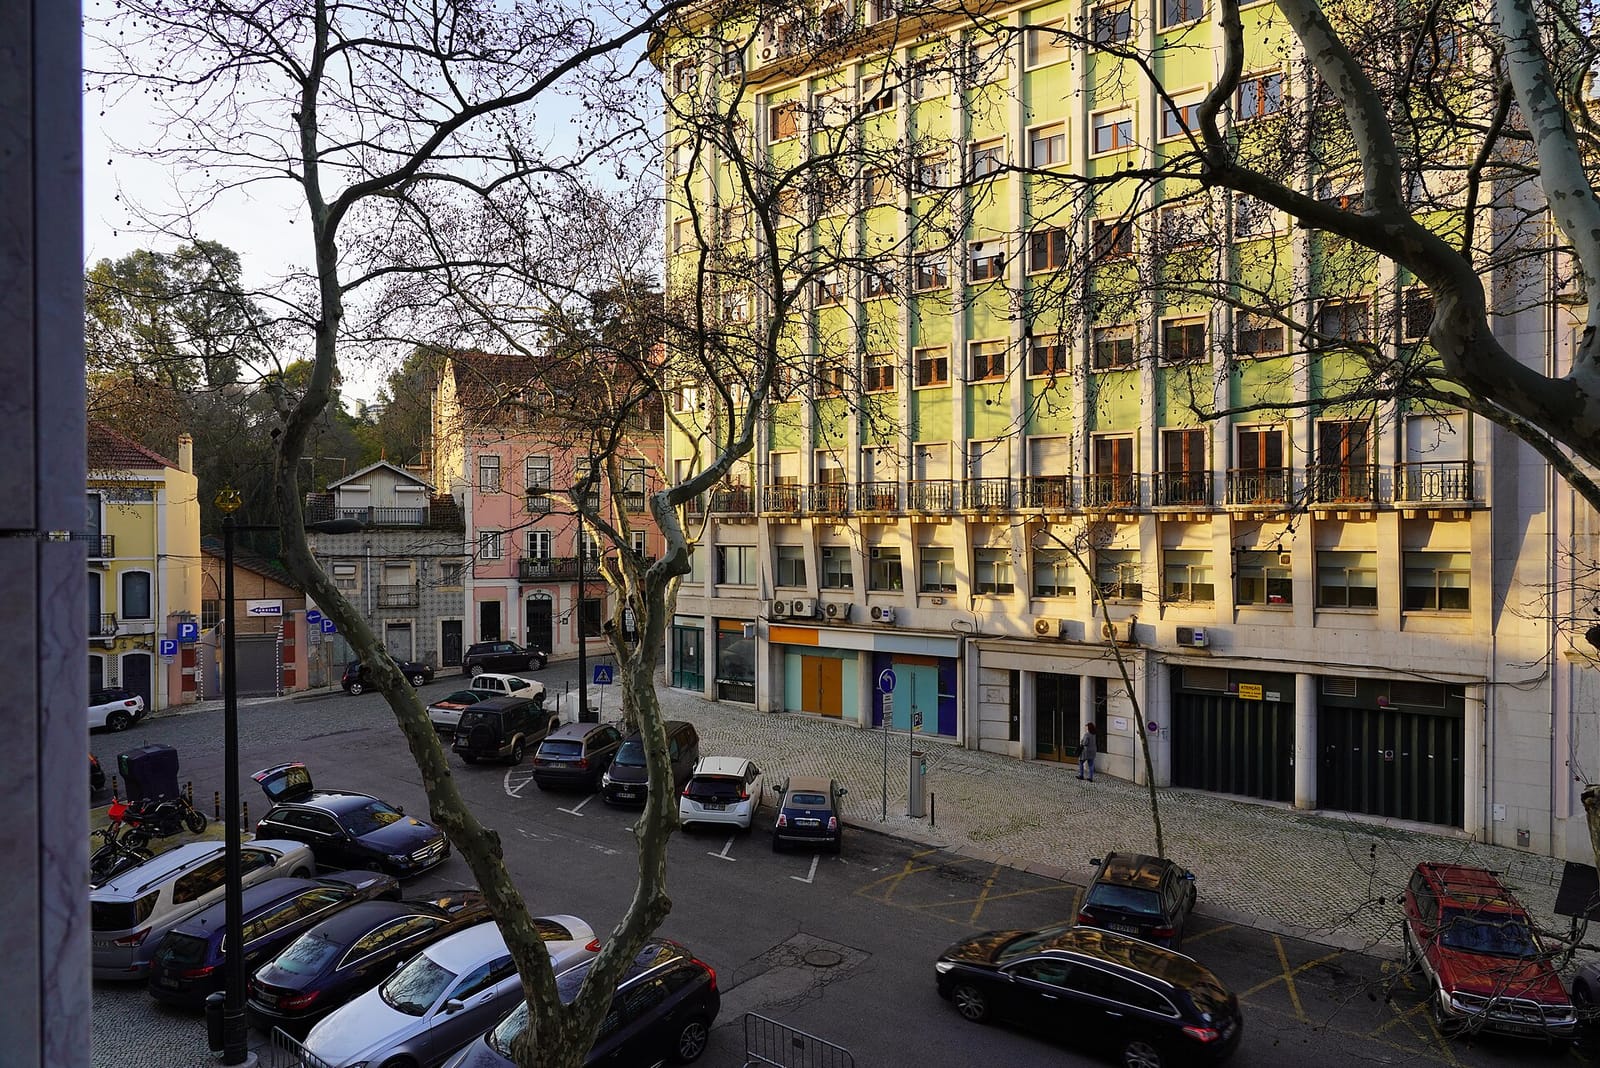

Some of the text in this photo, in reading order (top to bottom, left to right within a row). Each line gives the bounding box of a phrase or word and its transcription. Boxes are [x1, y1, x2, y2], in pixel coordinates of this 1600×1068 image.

[182, 624, 194, 637] P
[324, 619, 333, 632] P
[163, 641, 174, 654] P
